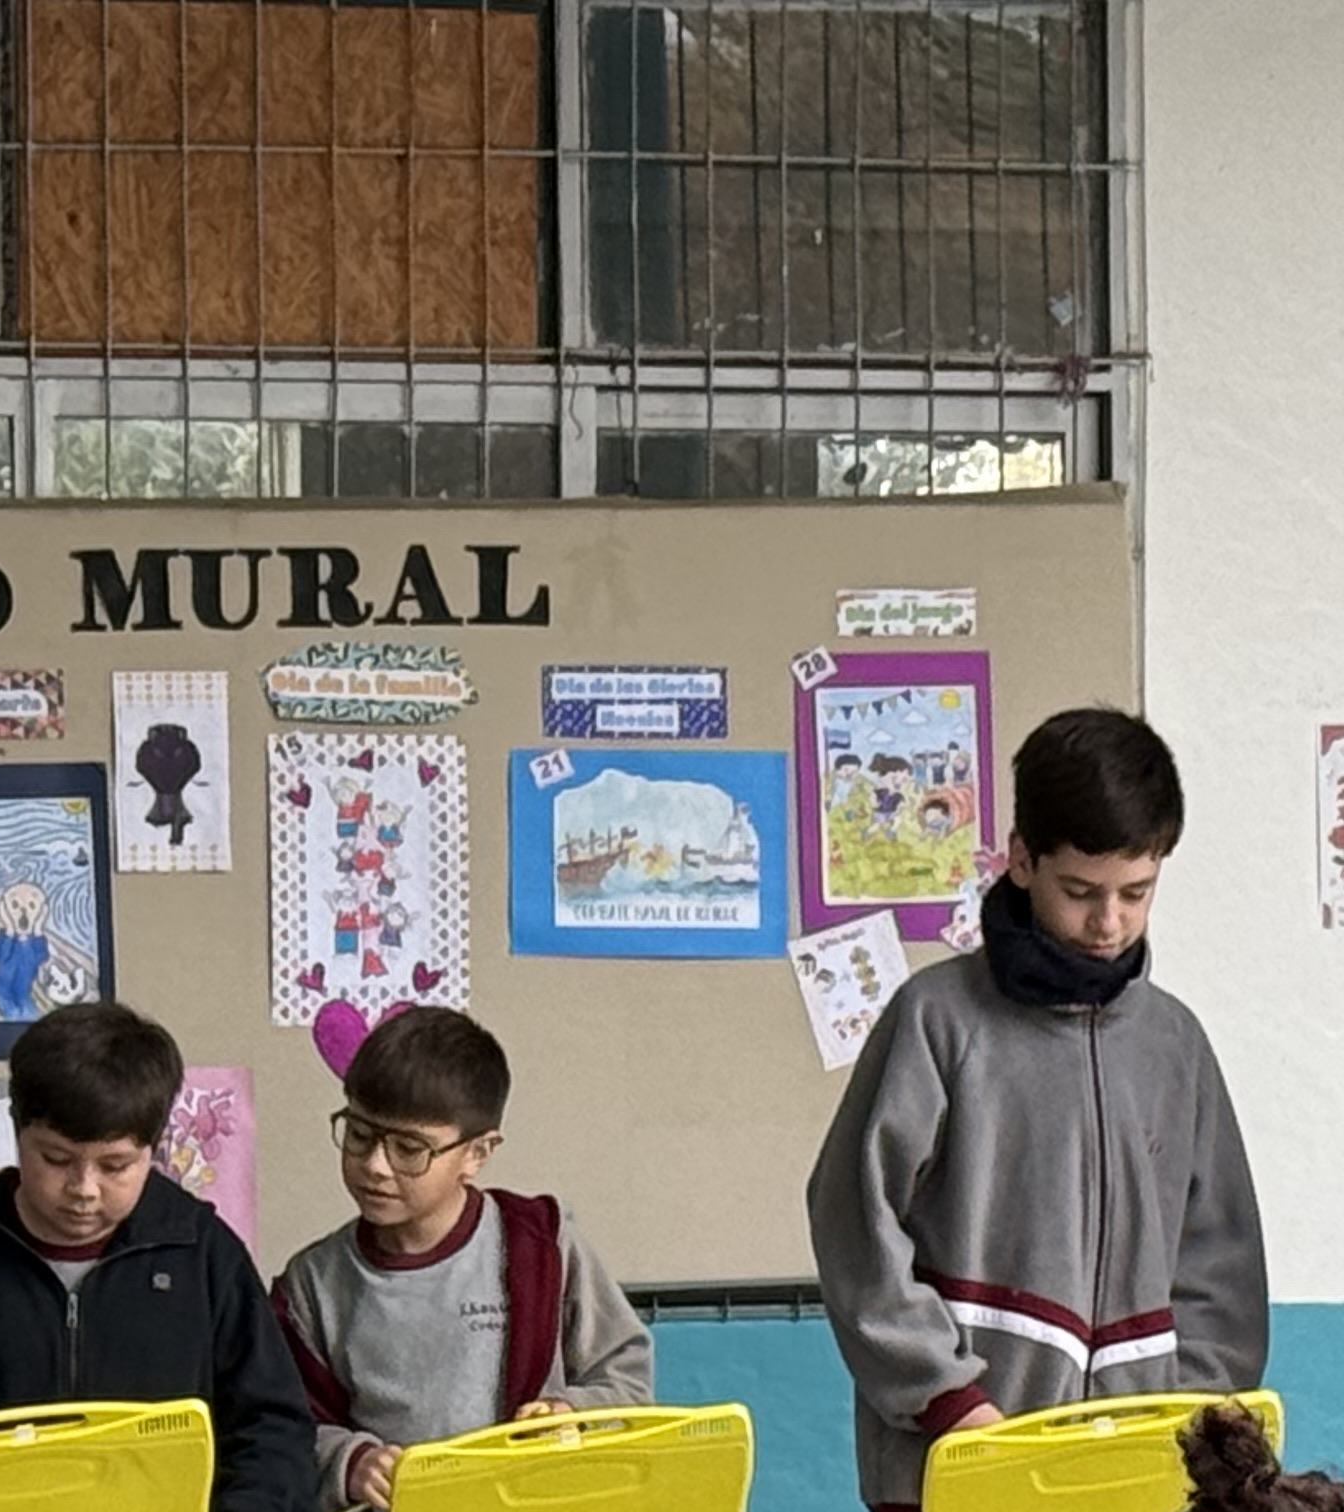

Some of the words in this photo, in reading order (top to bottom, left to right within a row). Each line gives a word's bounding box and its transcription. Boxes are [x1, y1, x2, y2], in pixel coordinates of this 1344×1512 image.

[68, 543, 551, 632] MURAL
[798, 653, 827, 682] 28
[315, 673, 344, 693] de
[347, 673, 371, 694] la
[375, 674, 462, 697] familia
[589, 678, 613, 694] de
[616, 678, 643, 694] las
[647, 678, 716, 695] Glorias
[273, 736, 303, 761] 15
[535, 753, 566, 780] 21
